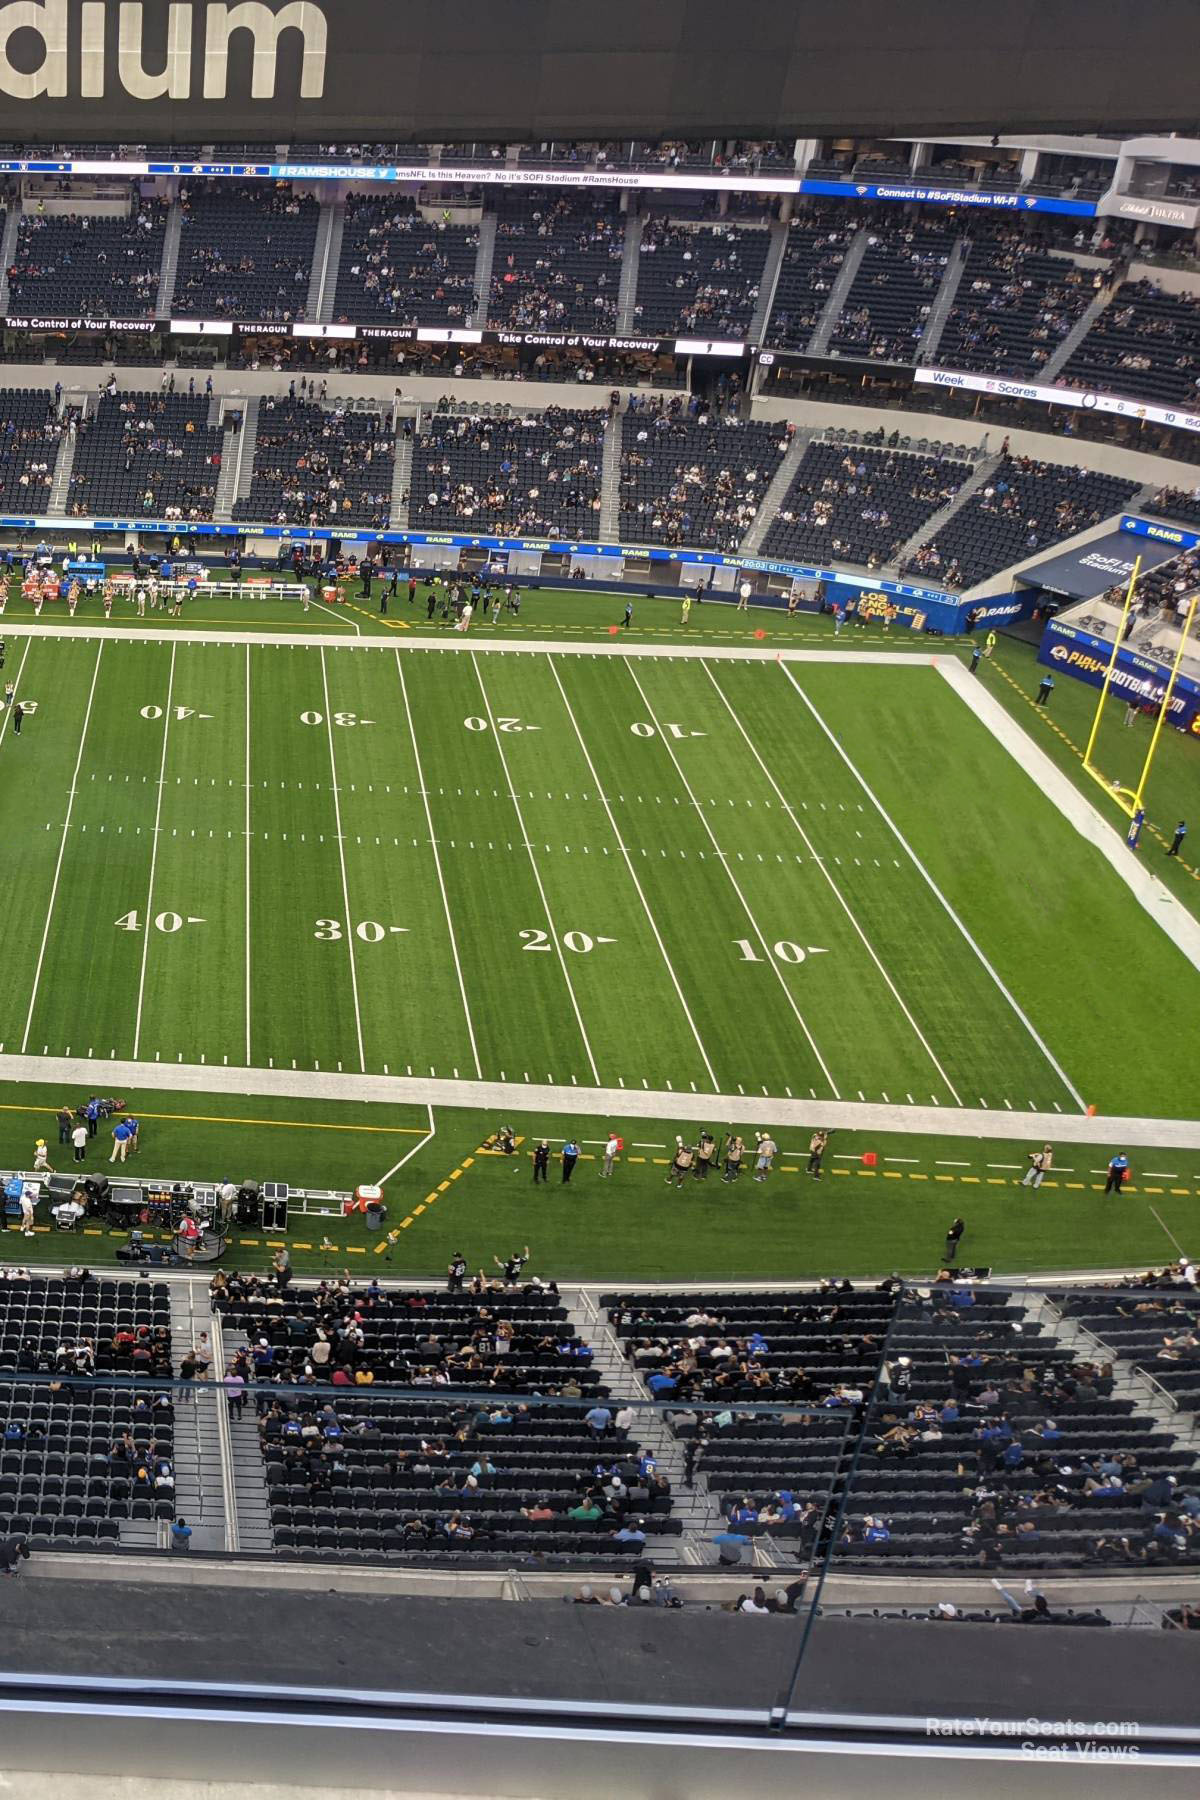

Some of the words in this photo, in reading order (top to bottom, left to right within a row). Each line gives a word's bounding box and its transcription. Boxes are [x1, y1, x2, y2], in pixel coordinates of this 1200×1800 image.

[278, 167, 376, 177] #RAMSHOUSE
[438, 170, 453, 179] this
[454, 171, 491, 180] Heaven?
[495, 172, 507, 180] No
[508, 172, 521, 181] it's
[545, 173, 580, 183] Stadium
[582, 174, 639, 185] #RamsHouse
[876, 187, 915, 199] Connect
[916, 189, 926, 199] to
[927, 191, 991, 204] #SoFiStadium
[993, 196, 1017, 205] Wi-Fi
[5, 318, 29, 328] Take
[31, 318, 69, 329] Control
[71, 319, 82, 329] of
[84, 320, 107, 329] Your
[110, 320, 156, 332] Recovery
[238, 325, 288, 334] THERAGUN
[361, 329, 412, 338] THERAGUN
[497, 333, 522, 343] Take
[524, 334, 565, 346] Control
[568, 335, 579, 346] of
[581, 337, 607, 347] Your
[609, 338, 659, 352] Recovery
[933, 372, 964, 386] Week
[997, 383, 1037, 398] Scores
[1117, 402, 1124, 411] 6
[1164, 413, 1176, 422] 10
[238, 527, 265, 535] RAMS
[331, 532, 358, 541] RAMS
[1147, 527, 1183, 543] RAMS
[523, 542, 551, 550] RAMS
[621, 549, 650, 557] RAMS
[723, 558, 744, 567] RAM
[1079, 558, 1128, 576] Stadium
[859, 591, 889, 602] LOS
[1050, 623, 1077, 638] RAMS
[1132, 657, 1159, 672] RAMS
[114, 910, 183, 933] 40
[314, 919, 386, 943] 30
[518, 929, 594, 954] 20
[731, 939, 806, 964] 10
